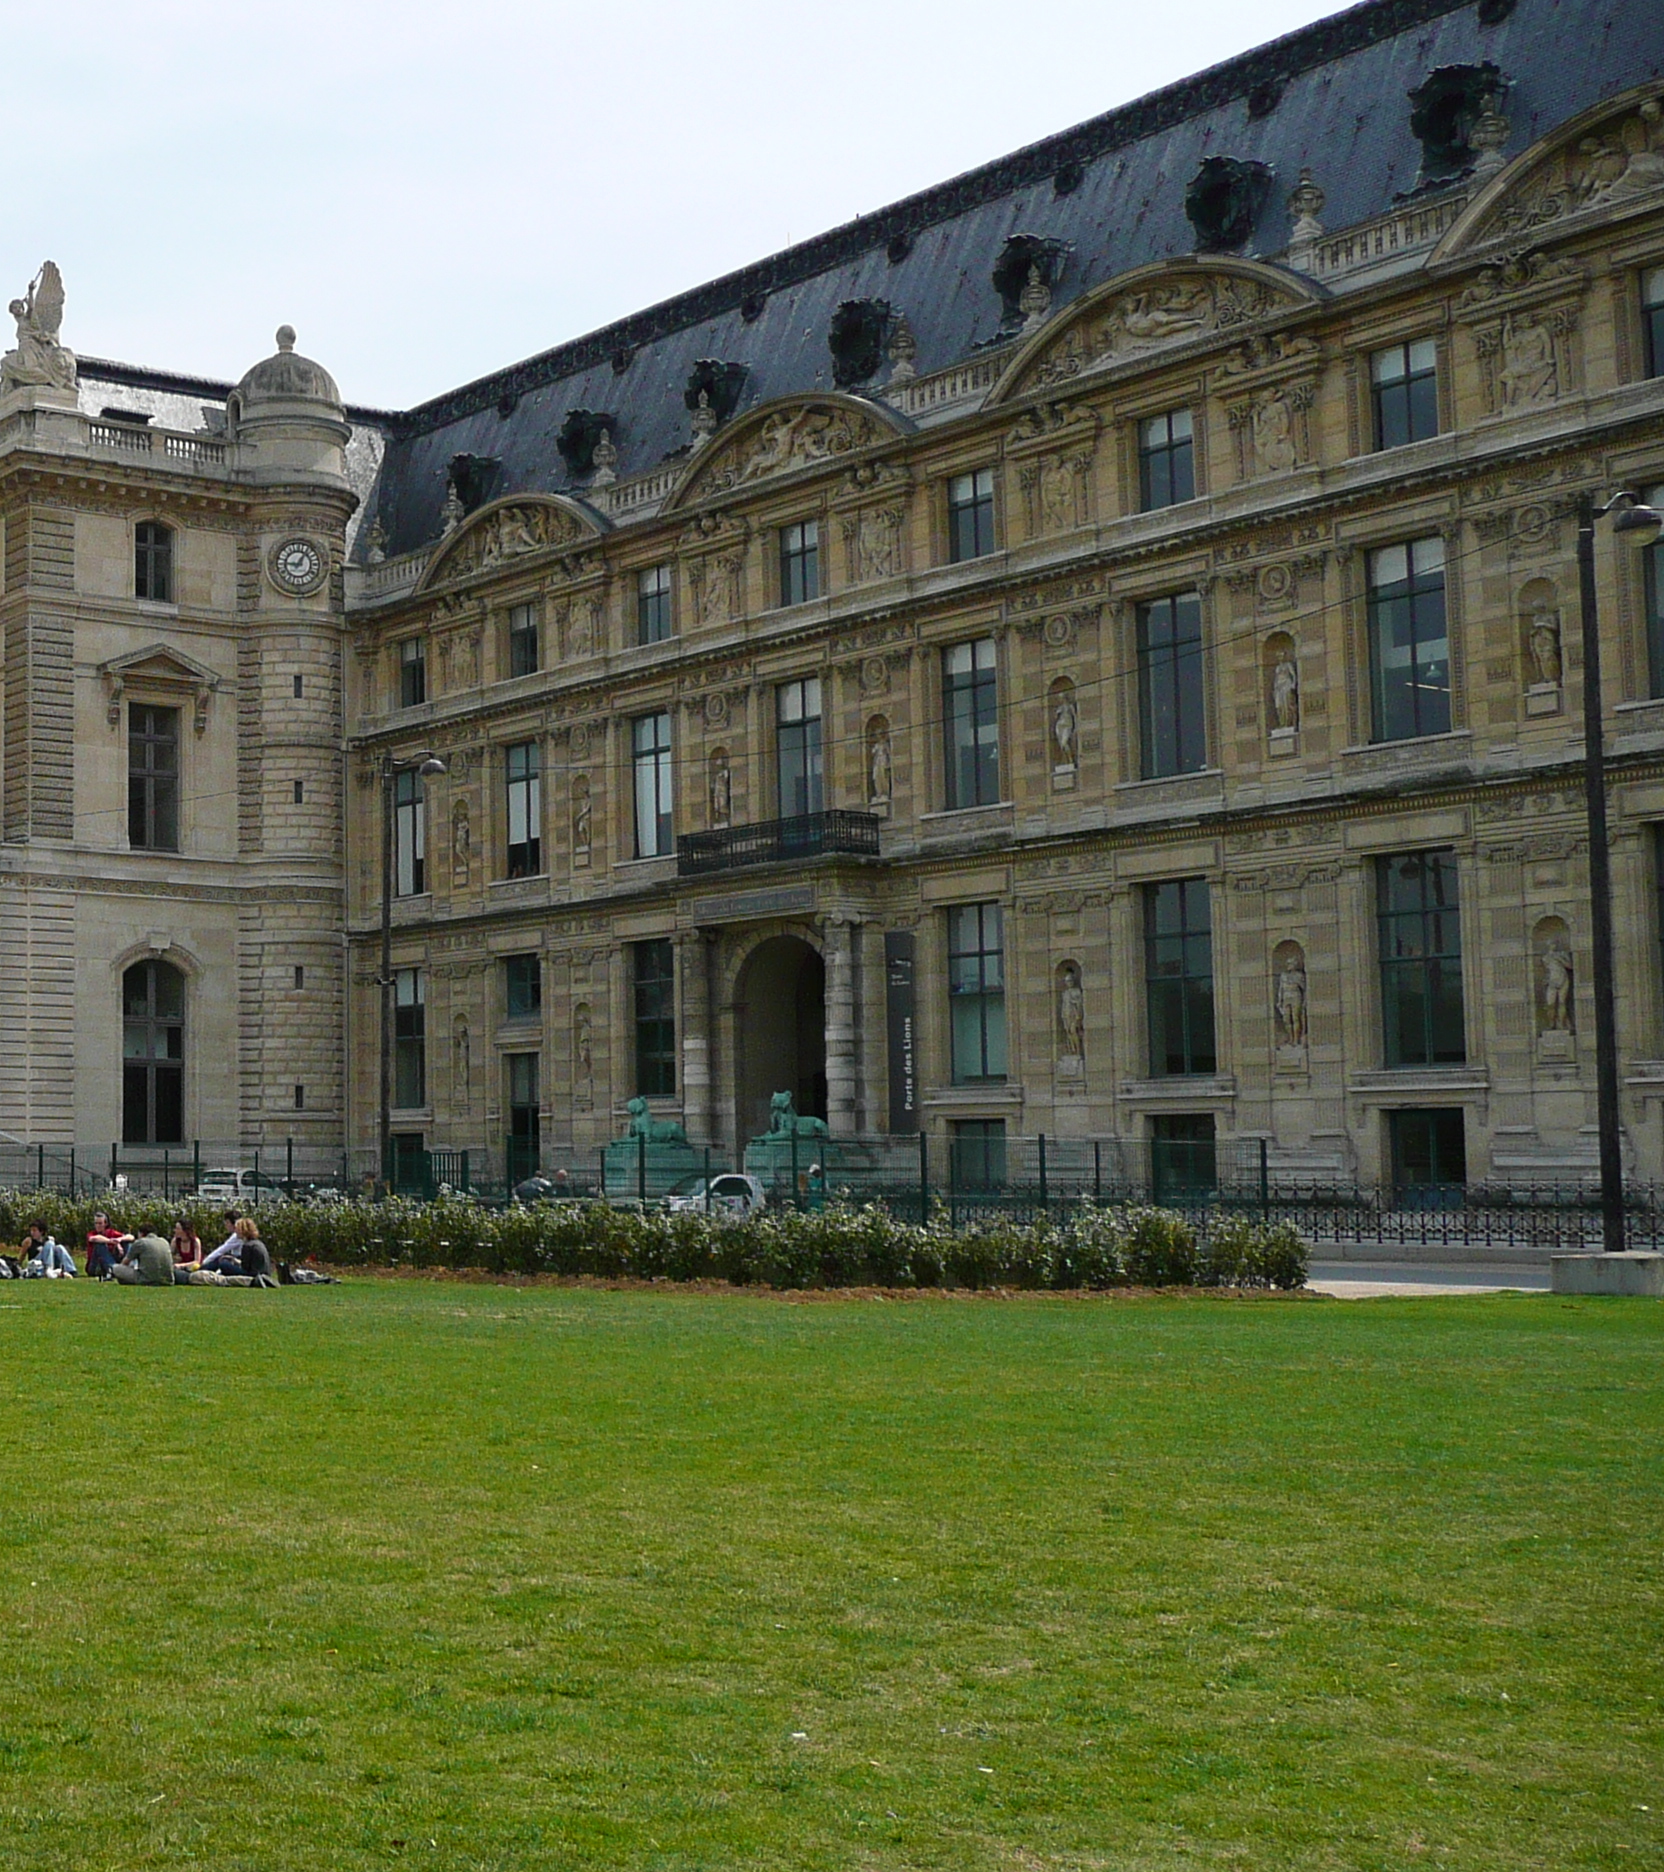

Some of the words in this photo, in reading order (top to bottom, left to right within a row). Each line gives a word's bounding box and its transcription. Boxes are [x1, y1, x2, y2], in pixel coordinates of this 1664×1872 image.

[903, 1016, 911, 1050] Lions
[903, 1053, 912, 1075] des
[904, 1077, 913, 1111] Porte
